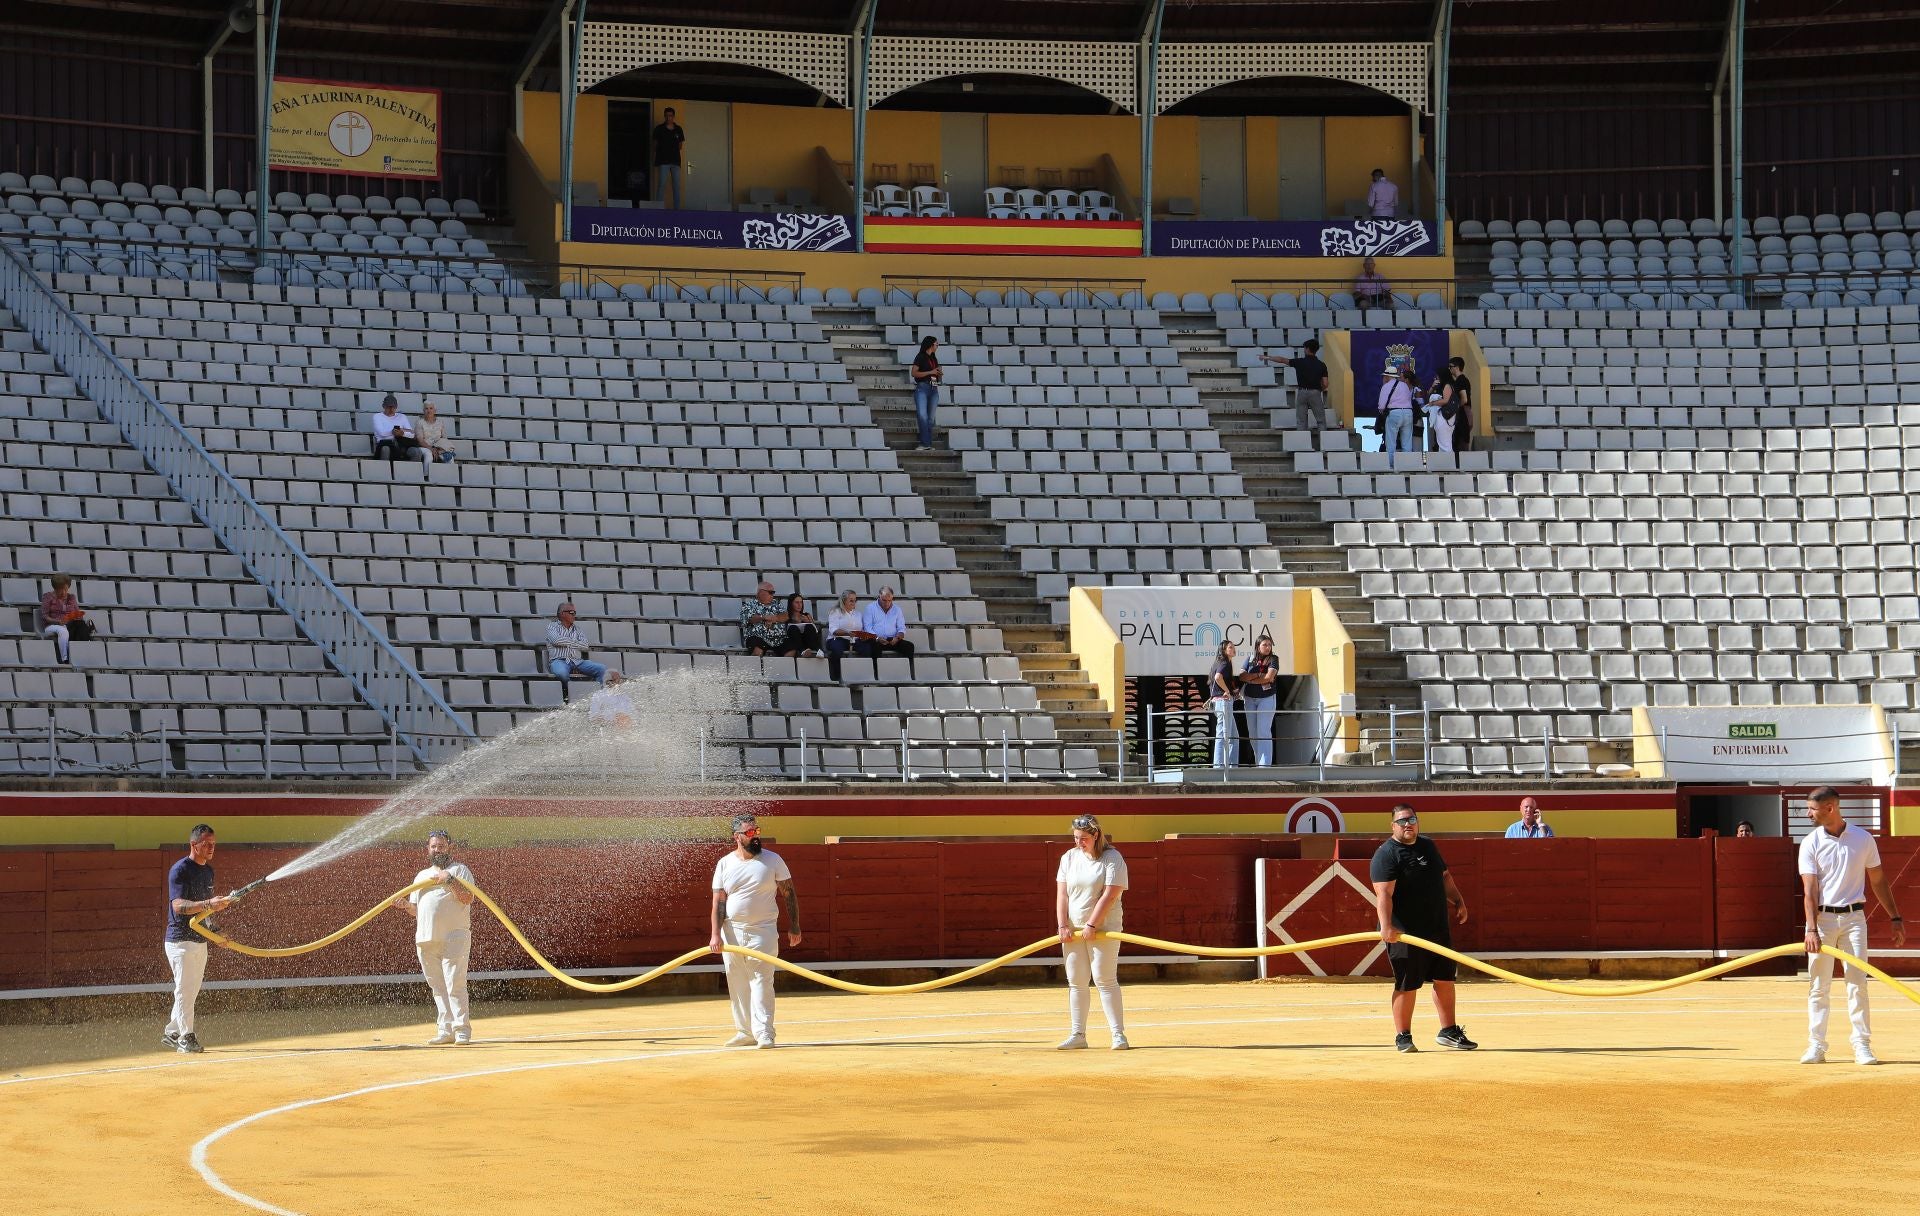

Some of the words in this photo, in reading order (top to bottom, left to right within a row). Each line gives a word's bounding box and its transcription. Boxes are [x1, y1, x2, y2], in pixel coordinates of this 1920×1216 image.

[270, 98, 300, 115] EÑA
[301, 92, 363, 105] TAURINA
[366, 95, 436, 134] PALENTINA
[591, 223, 656, 239] DIPUTACIÓN
[657, 227, 672, 239] DE
[673, 226, 723, 241] PALENCIA
[1171, 236, 1235, 249] DIPUTACIÓN
[1236, 239, 1250, 250] DE
[1251, 237, 1301, 250] PALENCIA
[1119, 610, 1240, 619] DIPUTACIÓN
[1256, 611, 1276, 619] DE
[1731, 725, 1774, 737] SALIDA
[1713, 745, 1789, 755] ENFERMERIA
[1309, 816, 1317, 833] 1
